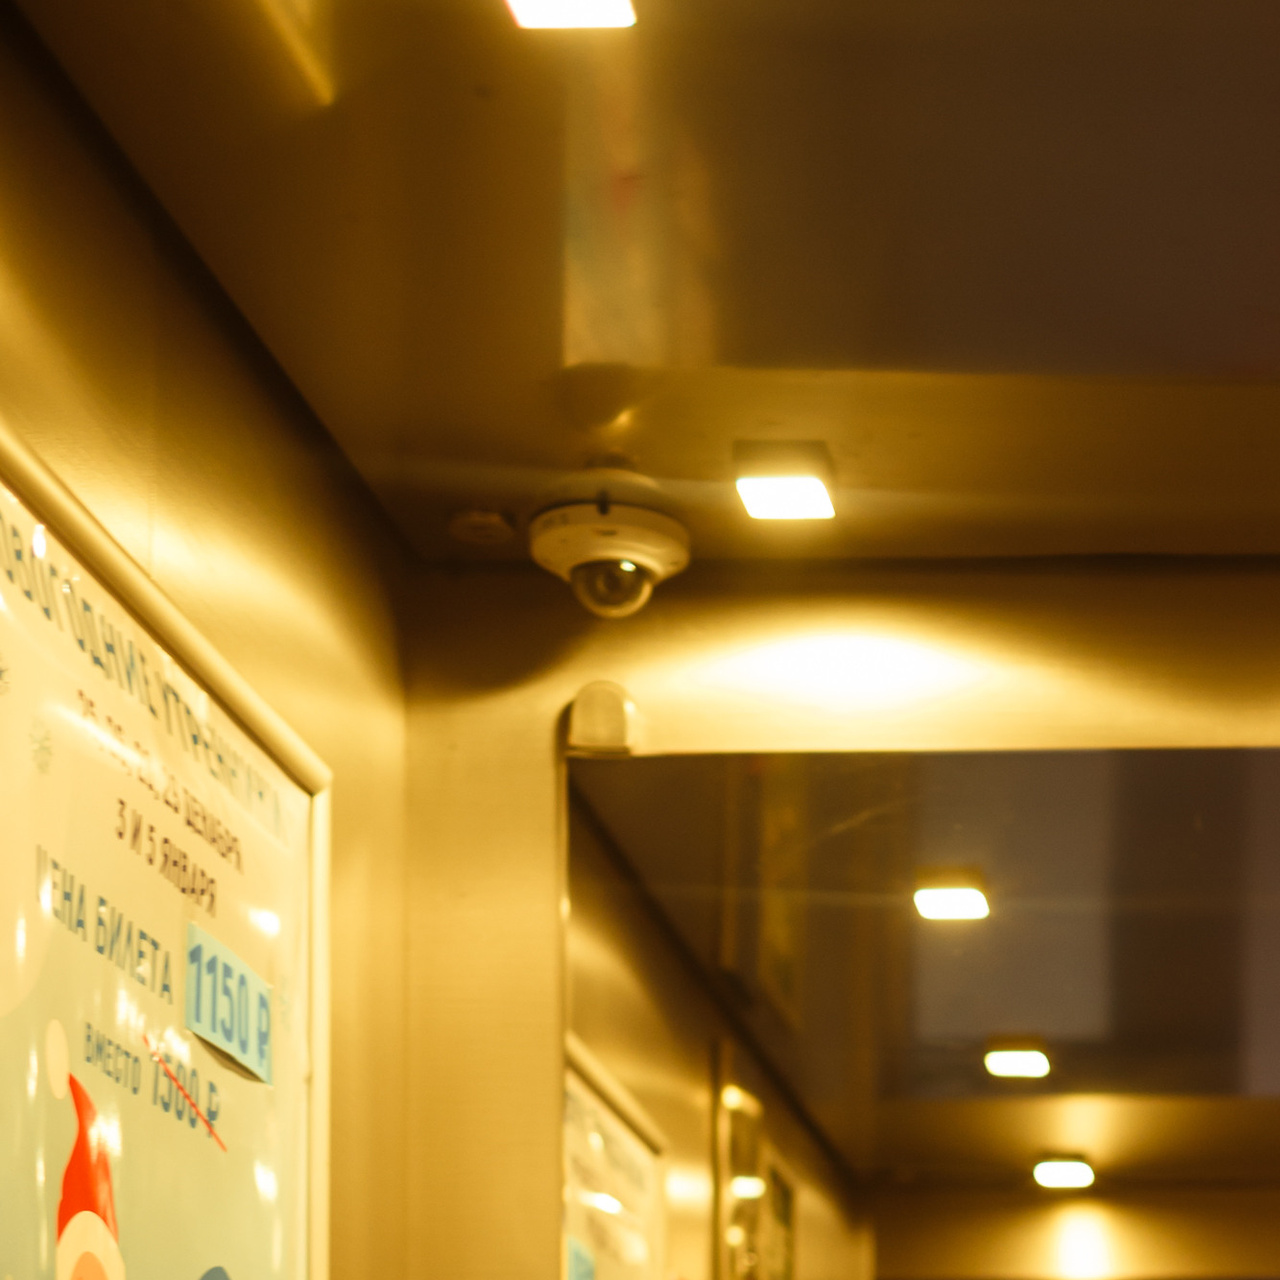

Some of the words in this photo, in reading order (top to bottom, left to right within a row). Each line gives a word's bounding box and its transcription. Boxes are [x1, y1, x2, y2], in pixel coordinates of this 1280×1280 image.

[115, 797, 127, 840] 3
[146, 823, 156, 867] 5
[160, 837, 217, 918] ЯНВАРЯ
[95, 896, 174, 1005] БИЛЕТА
[188, 944, 250, 1055] 1150
[84, 1021, 141, 1095] ВМЕСТО
